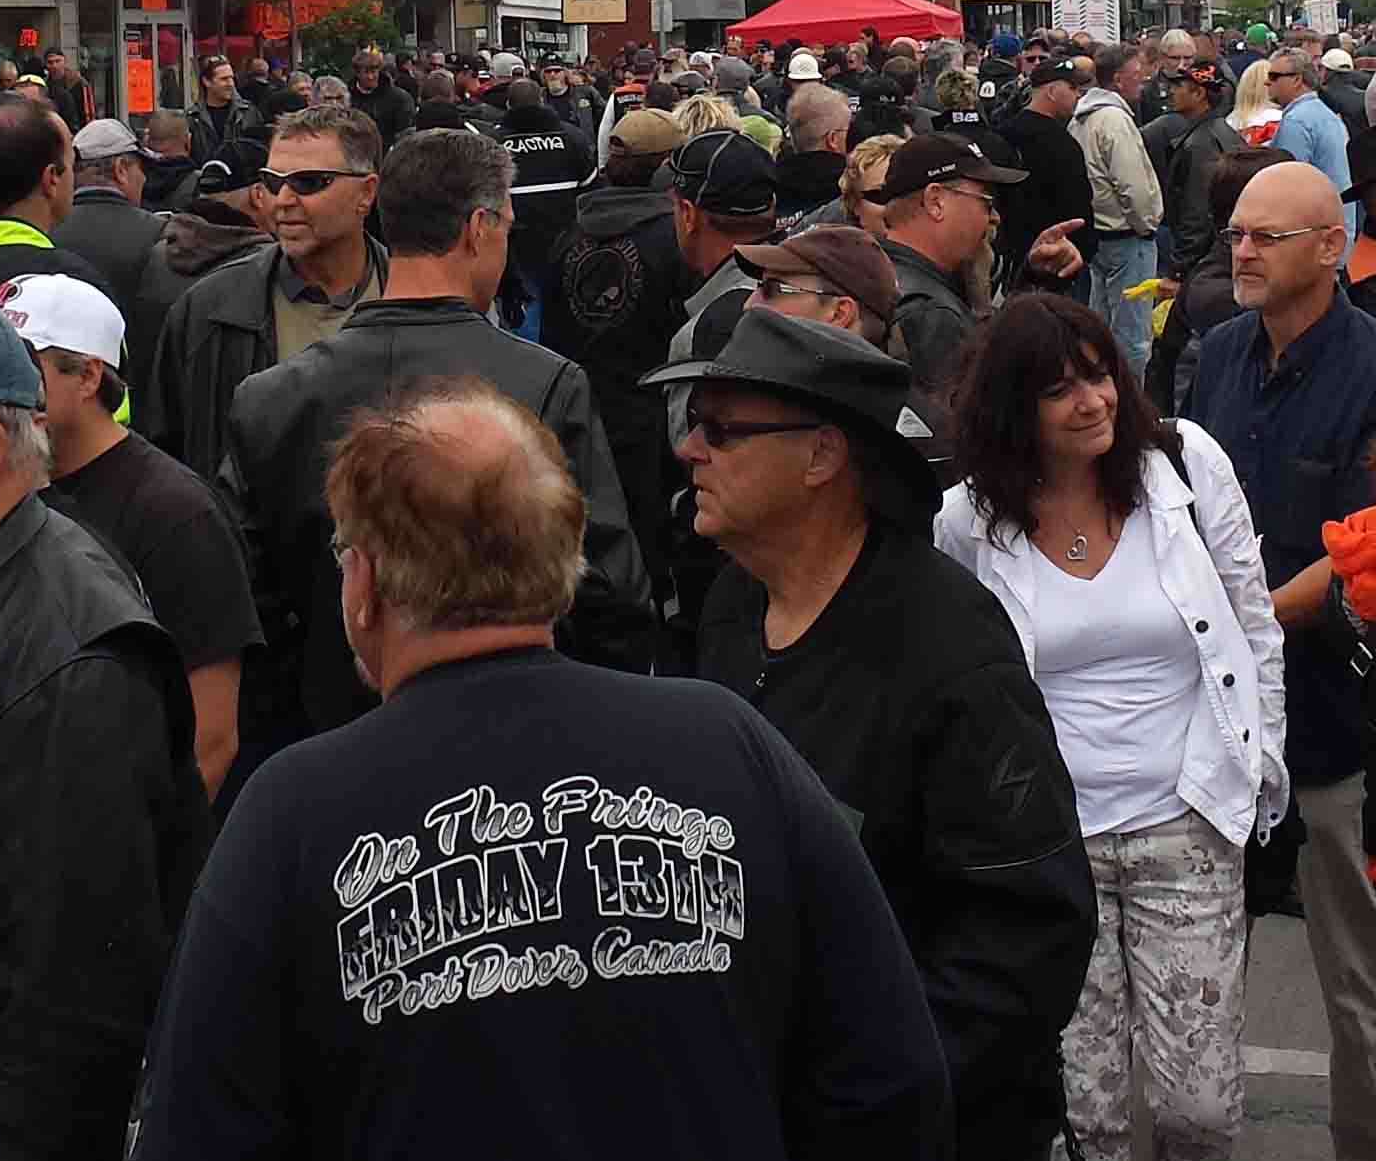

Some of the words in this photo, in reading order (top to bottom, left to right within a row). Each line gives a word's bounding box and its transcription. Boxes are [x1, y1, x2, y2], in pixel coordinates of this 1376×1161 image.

[334, 833, 420, 907] On
[424, 785, 534, 855] The
[542, 775, 735, 856] Fringe
[337, 838, 568, 1000] FRIDAY
[586, 834, 745, 940] 13TH
[360, 957, 465, 1024] Port
[593, 926, 732, 979] Canada
